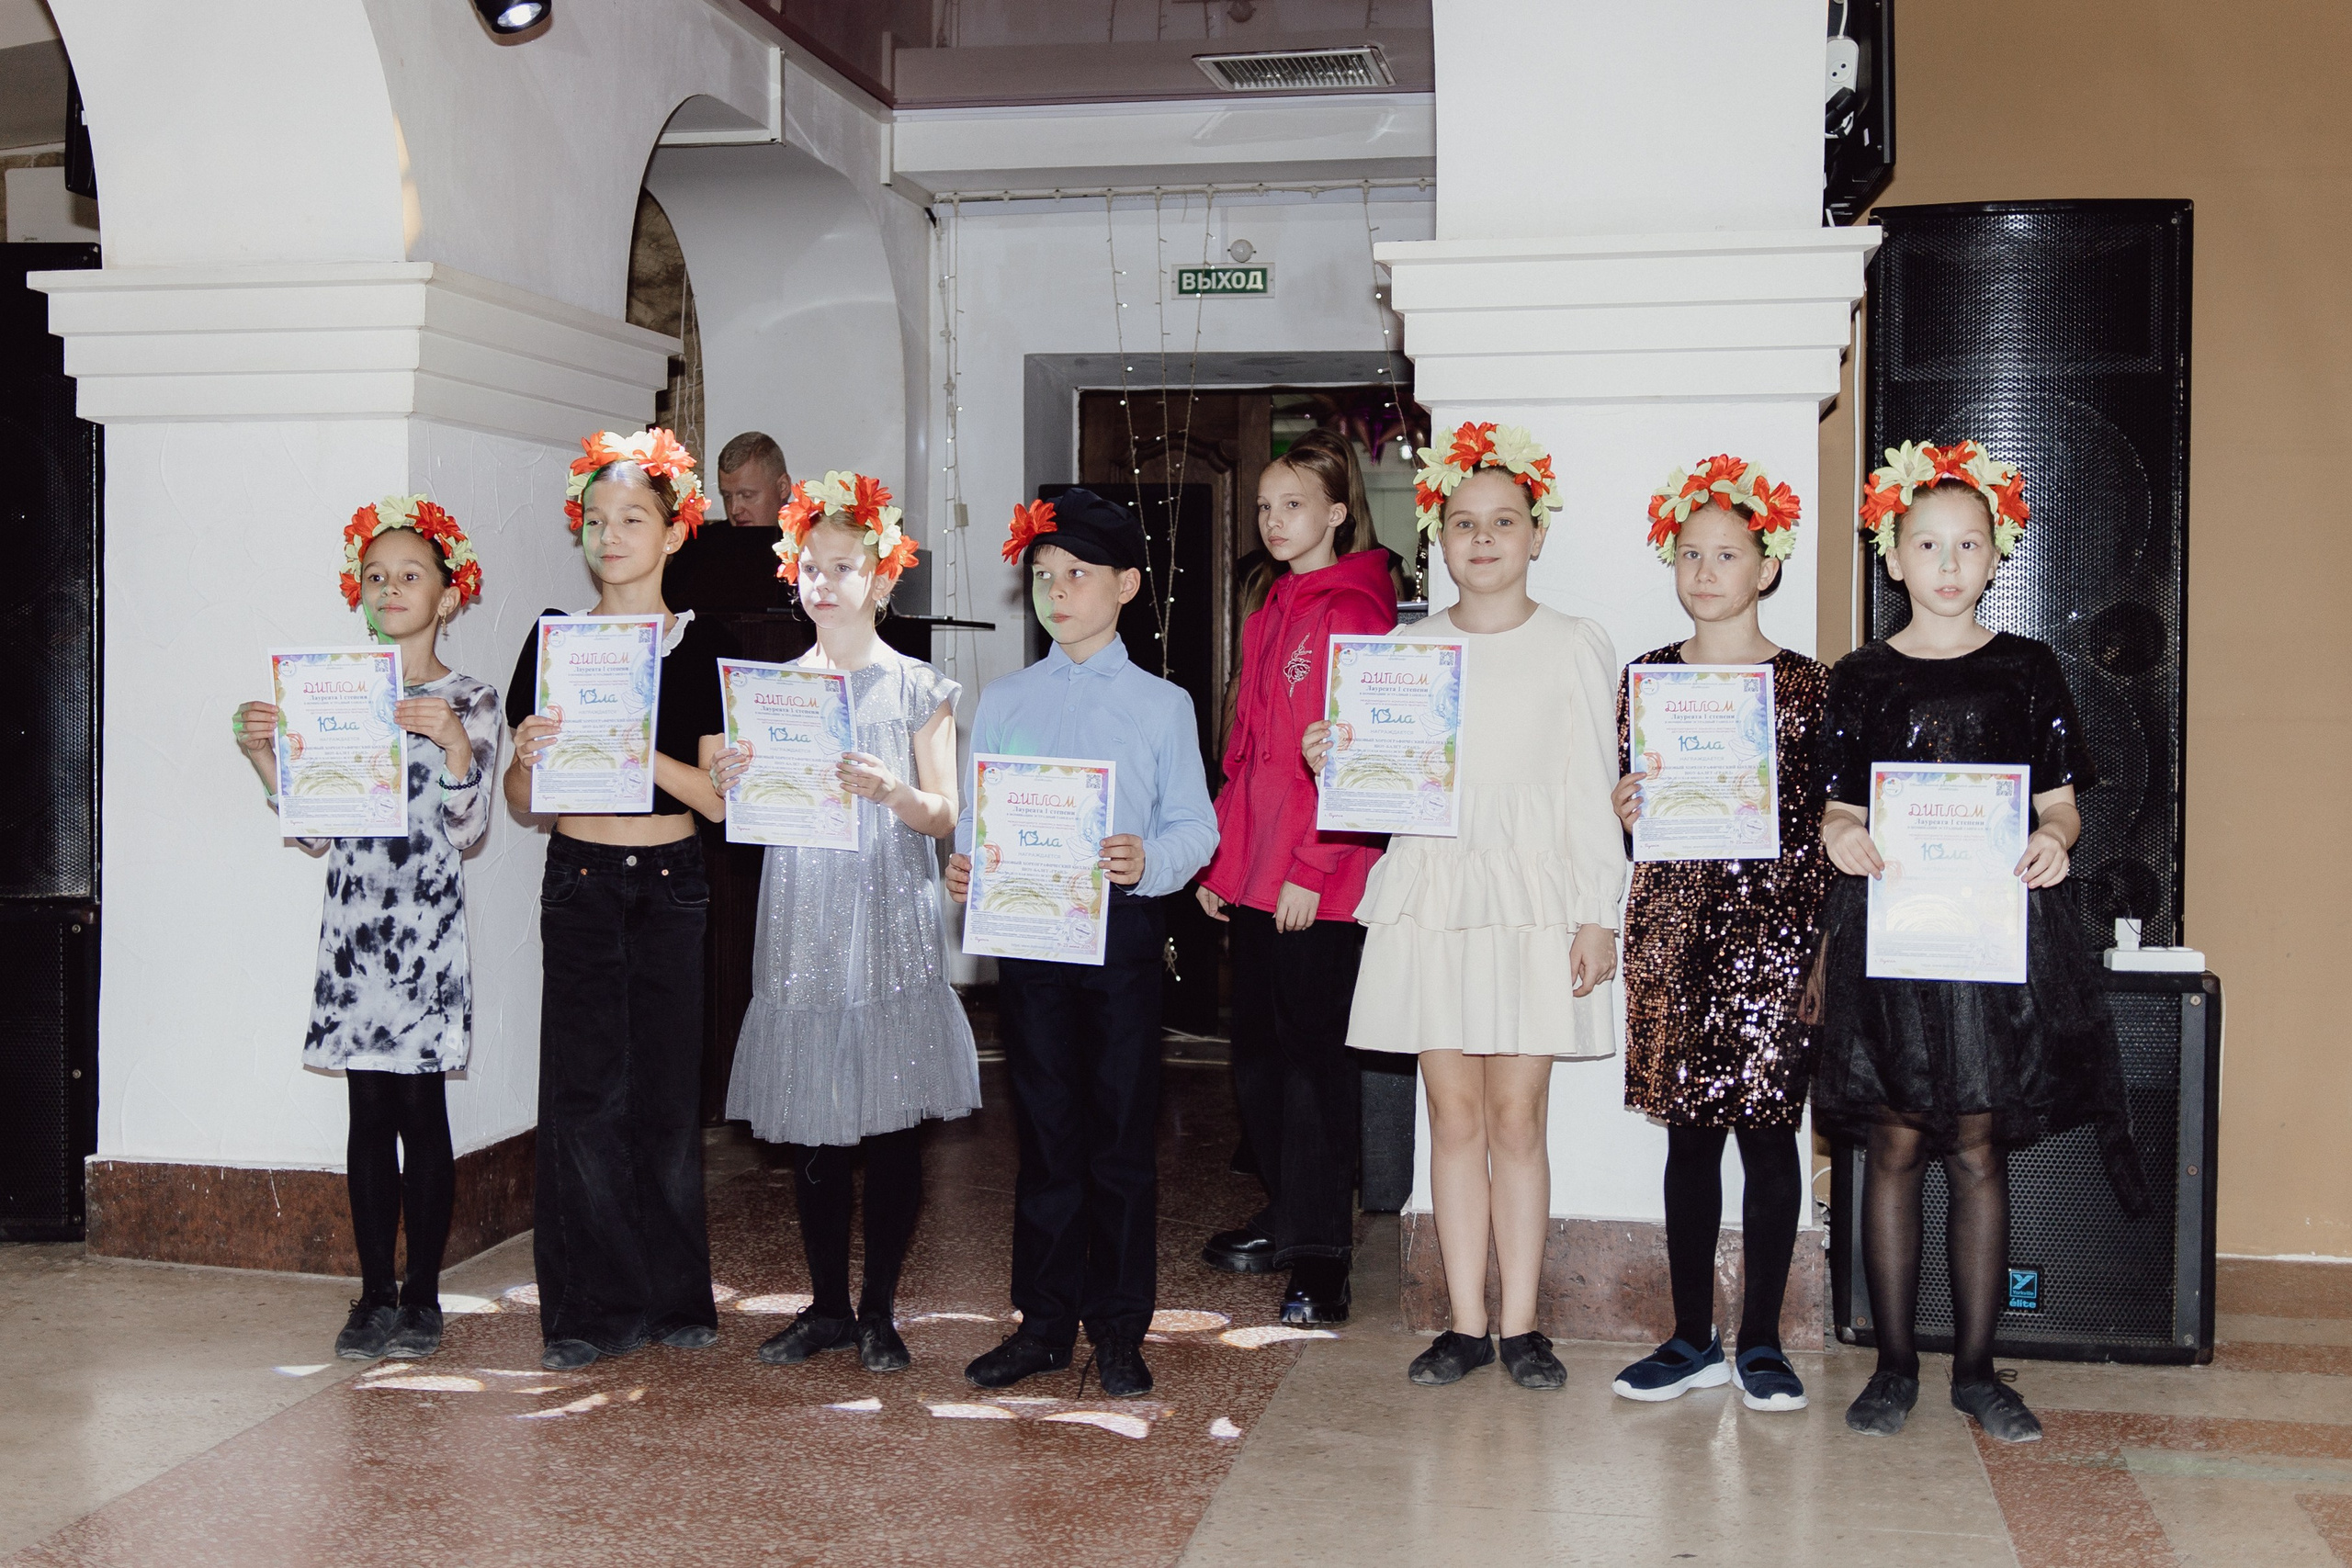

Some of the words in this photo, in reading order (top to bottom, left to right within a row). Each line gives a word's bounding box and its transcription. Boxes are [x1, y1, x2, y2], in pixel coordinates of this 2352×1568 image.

[1182, 270, 1263, 290] ВЫХОД
[570, 652, 630, 664] ДИПЛОМ
[1361, 671, 1430, 685] ДИПЛОМ
[302, 681, 368, 694] ДИПЛОМ
[579, 689, 617, 705] Юла
[754, 693, 820, 708] ДИПЛОМ
[1665, 700, 1736, 713] ДИПЛОМ
[1370, 707, 1416, 724] Юла
[317, 716, 360, 732] Юла
[768, 726, 811, 743] Юла
[1678, 735, 1725, 752] Юла
[1007, 792, 1077, 808] ДИПЛОМ
[1012, 807, 1043, 815] Лауреата
[1908, 804, 1986, 818] ДИПЛОМ
[1018, 829, 1063, 848] Юла
[1921, 842, 1971, 861] Юла
[2009, 1297, 2037, 1308] élite
